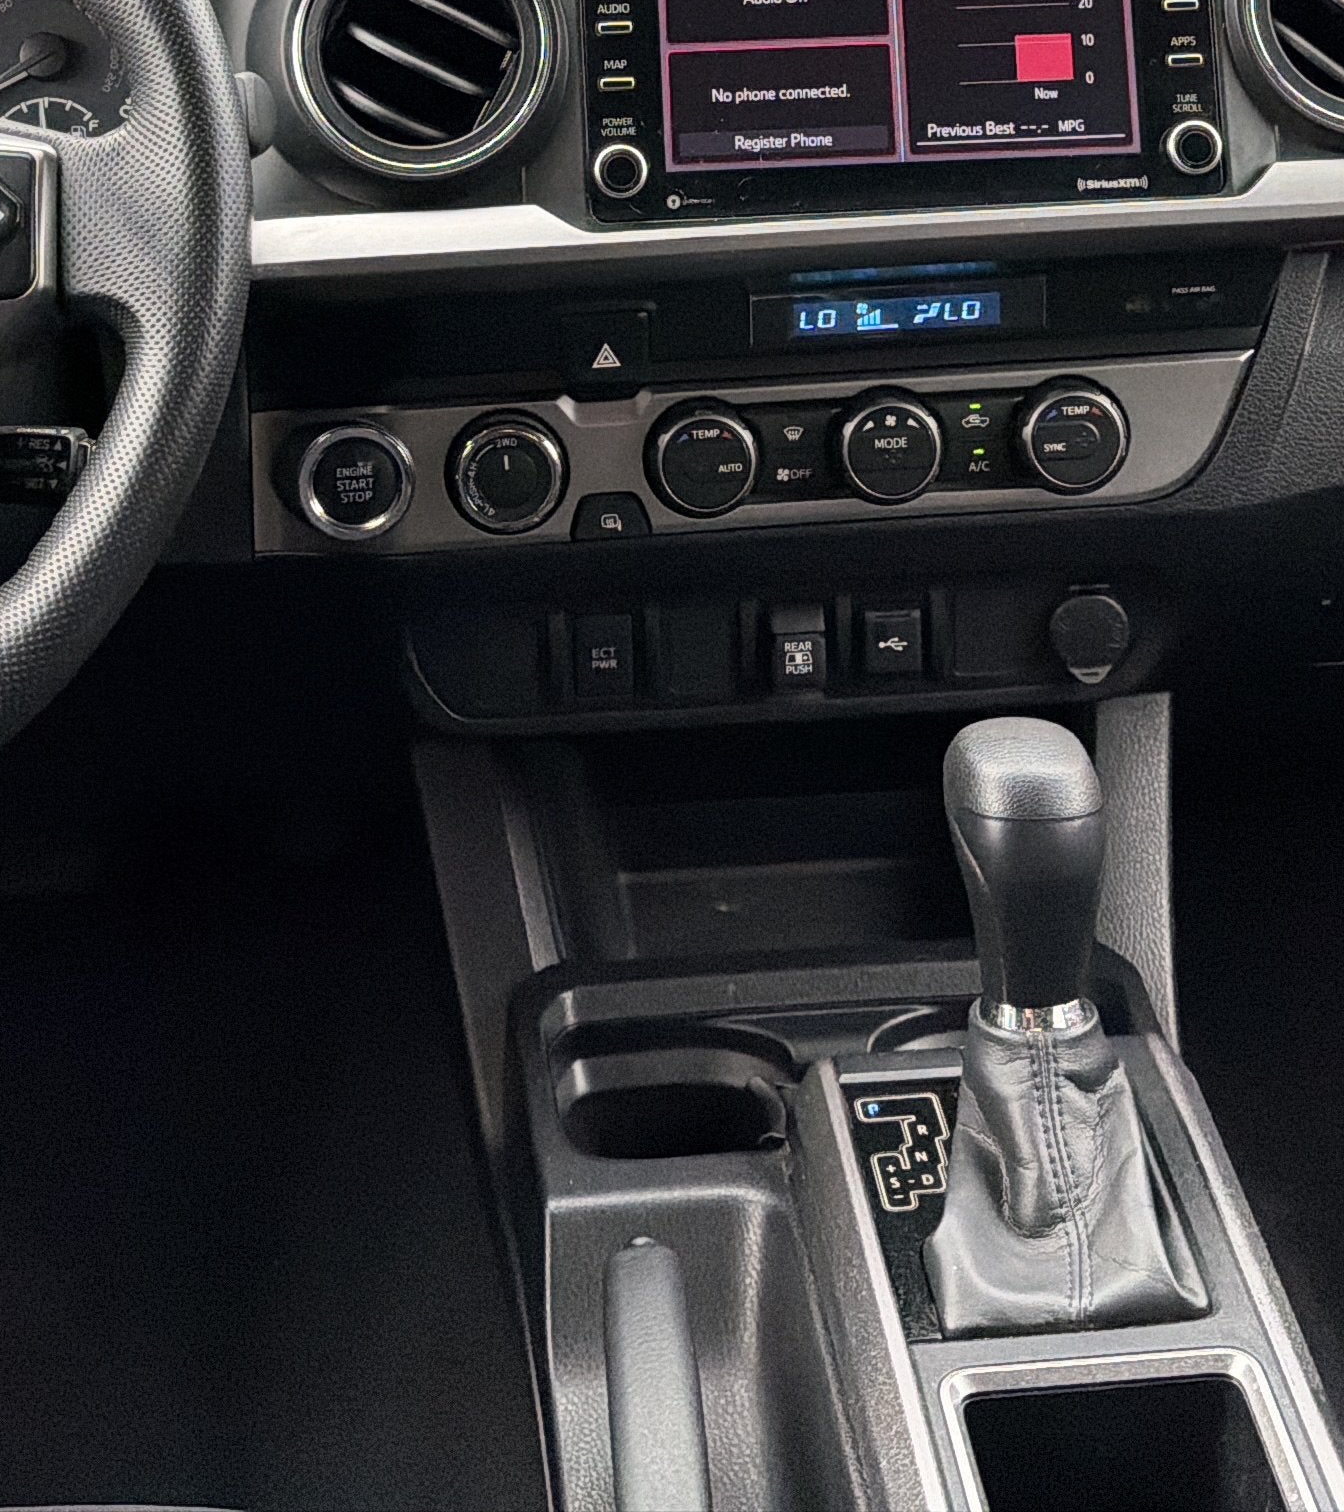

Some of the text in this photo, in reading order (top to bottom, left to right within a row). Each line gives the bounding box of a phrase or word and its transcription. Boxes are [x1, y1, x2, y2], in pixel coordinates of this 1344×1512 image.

[597, 2, 631, 14] AUDIO
[1081, 34, 1095, 47] 10
[1170, 36, 1197, 47] APPS
[604, 59, 628, 70] MAP
[1085, 71, 1095, 84] 0
[711, 84, 851, 104] No phone connected.
[1034, 87, 1058, 100] Now
[1176, 93, 1198, 103] TUNE
[1172, 103, 1203, 113] SCROLL
[88, 119, 99, 133] F
[602, 117, 634, 127] POWER
[600, 126, 637, 137] VOLUME
[927, 122, 983, 138] Previous
[985, 121, 1016, 136] Best
[1058, 120, 1085, 133] MPG
[734, 133, 833, 152] Register Phone
[943, 300, 982, 322] LO
[799, 309, 837, 330] LO
[1061, 404, 1091, 416] TEMP
[691, 428, 720, 439] TEMP
[496, 438, 518, 448] 2WD
[874, 437, 908, 449] MODE
[1043, 442, 1067, 453] SYNC
[336, 464, 373, 478] ENGINE
[718, 462, 743, 474] AUTO
[968, 460, 991, 473] A/C
[790, 468, 813, 480] OFF
[336, 478, 374, 491] START
[340, 490, 373, 504] STOP
[784, 641, 813, 652] REAR
[591, 647, 616, 659] ECT
[591, 659, 618, 671] PWR
[785, 664, 813, 676] PUSH
[916, 1124, 929, 1136] R
[915, 1151, 929, 1162] N
[890, 1177, 901, 1188] S
[922, 1174, 934, 1186] D
